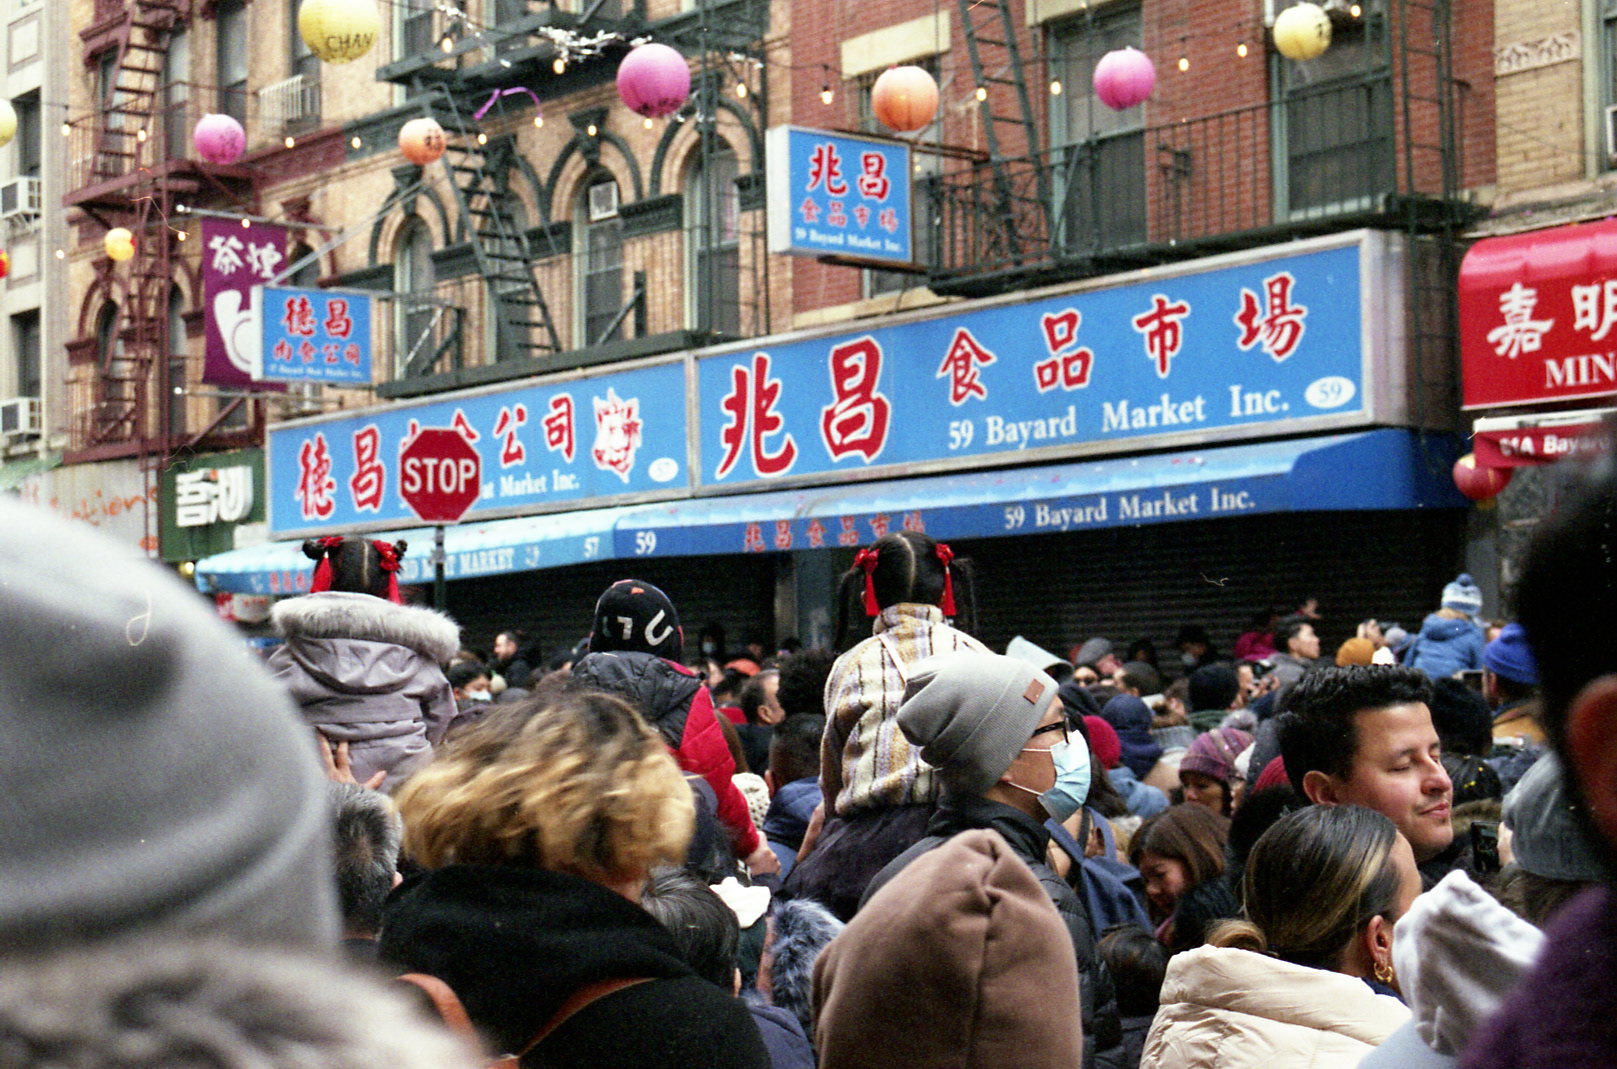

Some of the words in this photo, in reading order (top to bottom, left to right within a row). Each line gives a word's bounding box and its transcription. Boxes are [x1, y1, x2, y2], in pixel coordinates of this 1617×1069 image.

[806, 142, 890, 203] 兆昌
[281, 294, 353, 340] 德昌
[1544, 352, 1617, 388] MIN
[1318, 382, 1343, 400] 59
[948, 420, 974, 450] 59
[985, 406, 1077, 451] Bayard
[1102, 393, 1206, 433] Market
[1229, 384, 1289, 417] Inc.
[295, 392, 576, 520] 德昌公司
[404, 457, 477, 494] STOP
[500, 472, 547, 497] Market
[553, 468, 580, 492] Inc.
[1004, 504, 1025, 530] 59
[1035, 496, 1108, 532] Bayard
[1118, 491, 1199, 520] Market
[1210, 487, 1255, 512] Inc.
[459, 547, 515, 576] MARKET
[635, 530, 657, 556] 59
